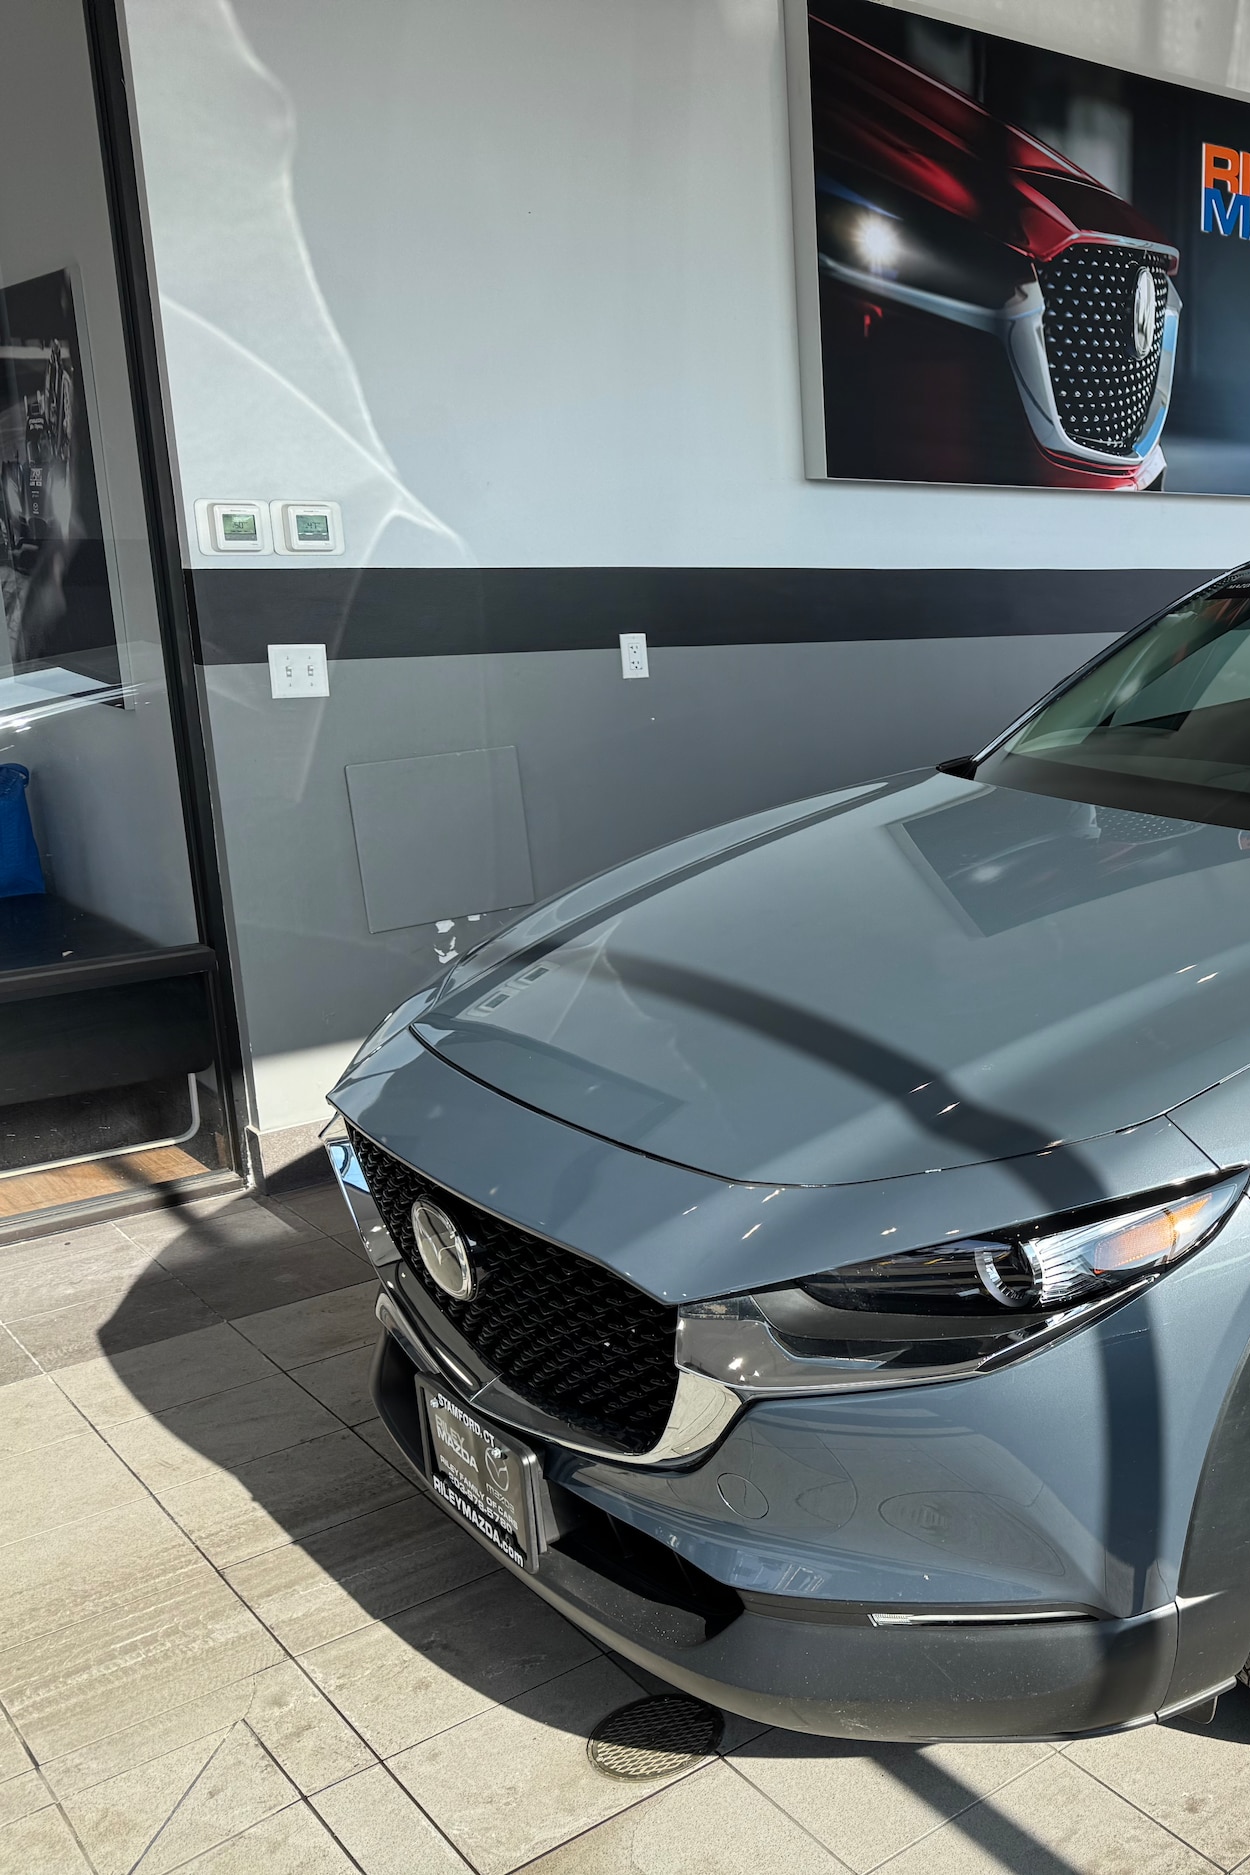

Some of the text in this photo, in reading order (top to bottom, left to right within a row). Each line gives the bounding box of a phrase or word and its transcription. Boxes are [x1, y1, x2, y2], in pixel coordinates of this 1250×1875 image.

[435, 1414, 465, 1446] RILEY
[436, 1426, 479, 1473] MAZDA
[482, 1429, 495, 1447] CT
[440, 1454, 518, 1530] RILEY FAMILY OF CARS
[432, 1475, 524, 1568] RILEYMAZDA.com
